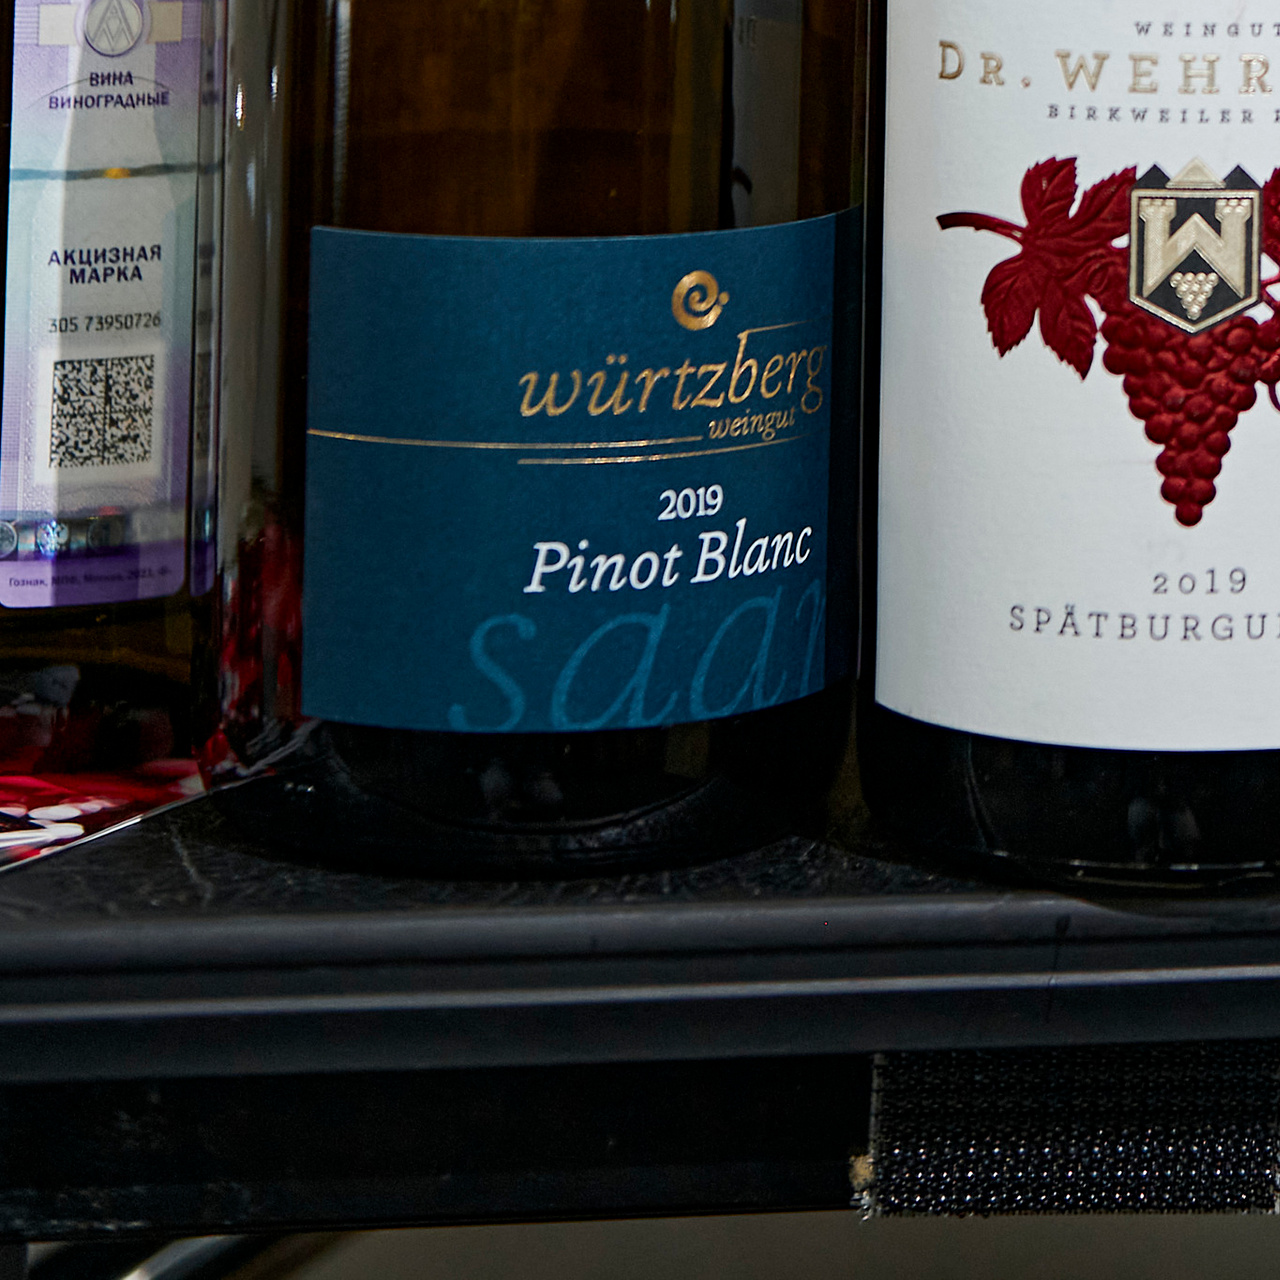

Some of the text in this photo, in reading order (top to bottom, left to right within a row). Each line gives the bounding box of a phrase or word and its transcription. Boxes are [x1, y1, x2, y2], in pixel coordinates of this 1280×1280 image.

[937, 39, 1032, 89] DR.
[89, 71, 134, 87] ВИНА
[48, 91, 170, 109] ВИНОГРАДНЫЕ
[1046, 104, 1255, 125] BIRKWEILER
[48, 245, 162, 267] АКЦИЗНАЯ
[69, 266, 143, 285] МАРКА
[48, 310, 162, 333] 305 73950726
[519, 321, 829, 416] würtzberg
[708, 406, 797, 441] weingut
[657, 485, 724, 521] 2019
[523, 518, 813, 594] Pinot Blanc
[1152, 567, 1248, 595] 2019
